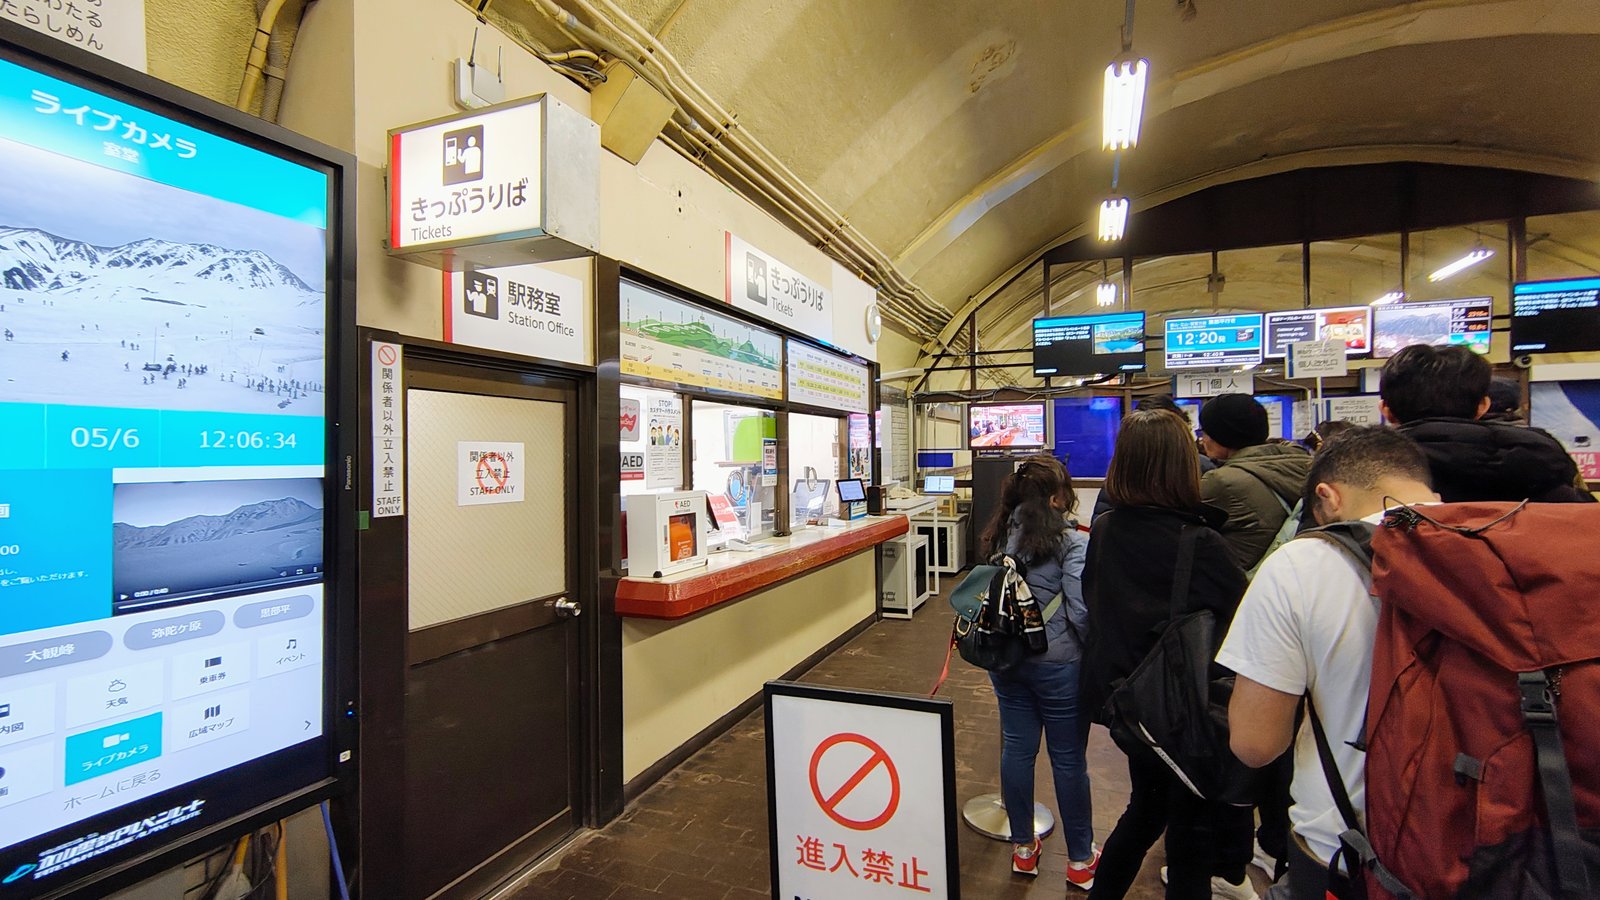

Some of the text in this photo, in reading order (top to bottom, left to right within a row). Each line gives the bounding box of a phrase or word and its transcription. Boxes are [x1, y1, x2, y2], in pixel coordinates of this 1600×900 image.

[30, 88, 198, 160] ライブカメラ
[102, 140, 140, 164] 室堂
[411, 177, 529, 222] きっぷうりば
[411, 225, 452, 241] Tickets
[507, 280, 561, 317] 駅務室
[770, 266, 824, 312] きっぷうりば
[771, 296, 794, 318] Tickets
[508, 311, 575, 337] Station Office
[1196, 381, 1202, 393] 1
[70, 427, 297, 451] 05/6 12:06:34
[382, 367, 394, 492] 関係者以外立入禁止
[469, 451, 514, 462] 関係者以外
[621, 456, 643, 467] AED
[475, 468, 510, 480] 立入禁止
[376, 496, 401, 506] STAFF
[470, 485, 515, 496] STAFF ONLY
[378, 505, 400, 515] ONLY
[680, 500, 690, 508] AED
[25, 643, 76, 664] 大観峰
[275, 652, 307, 666] イベント
[199, 672, 227, 686] 乗車券
[105, 697, 129, 709] 天気
[188, 717, 235, 739] 広域マップ
[82, 743, 149, 772] ライブカメラ
[63, 769, 162, 811] ホームに戻る
[796, 834, 931, 893] 進入禁止
